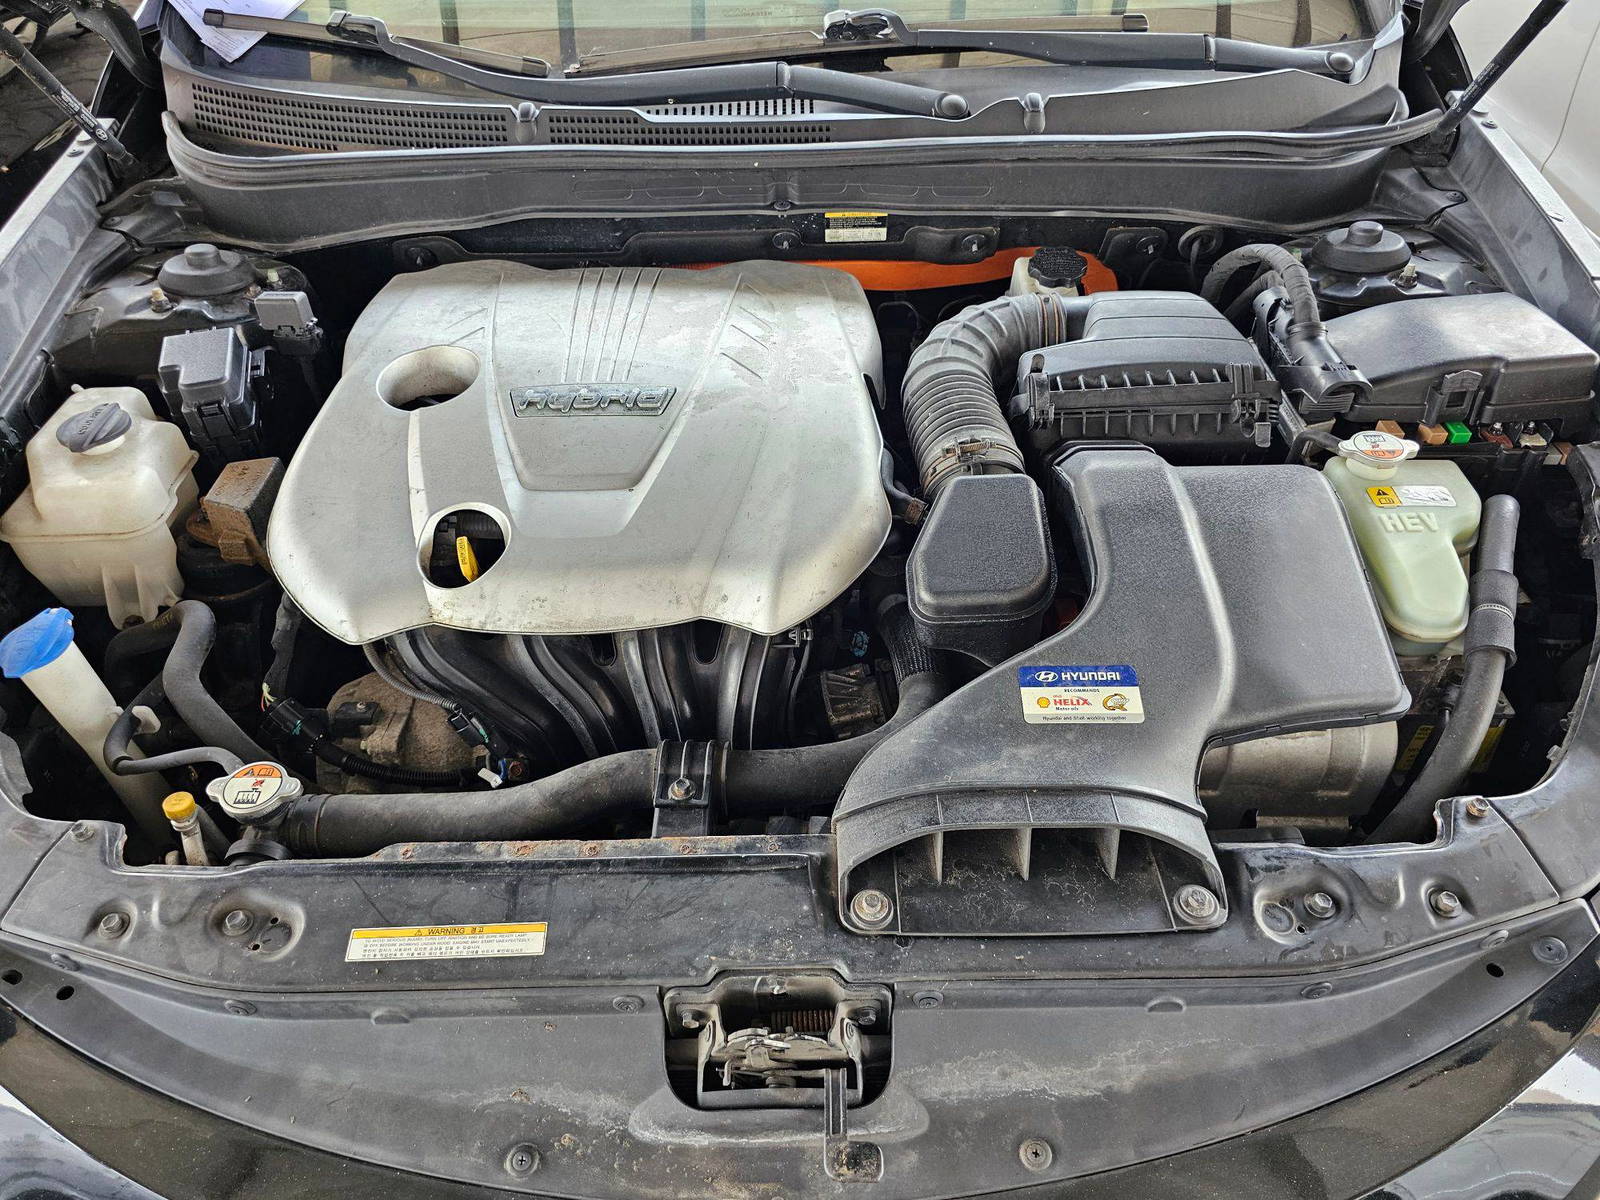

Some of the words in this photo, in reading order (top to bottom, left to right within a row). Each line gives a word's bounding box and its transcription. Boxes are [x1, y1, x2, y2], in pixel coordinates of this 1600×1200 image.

[1378, 511, 1440, 533] HEV
[1061, 671, 1121, 681] HYUNDAI
[1053, 698, 1090, 706] HELIX
[428, 927, 465, 936] WARNING
